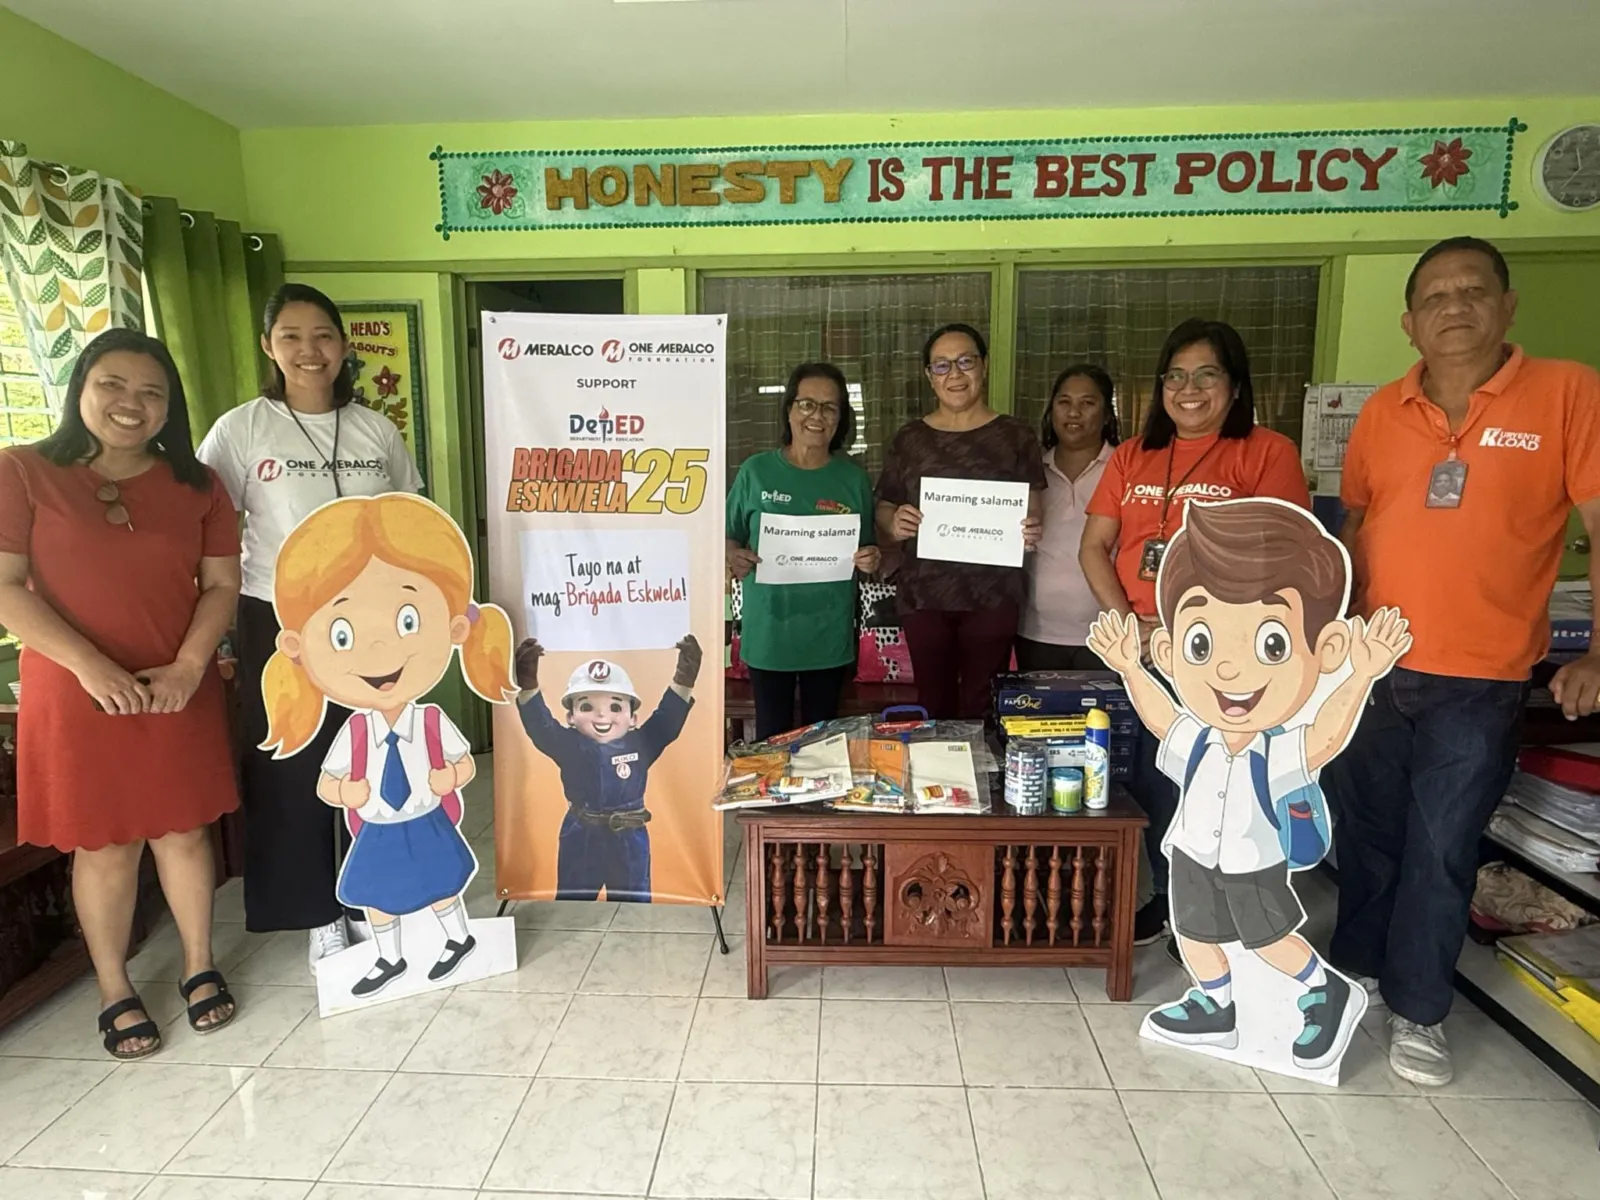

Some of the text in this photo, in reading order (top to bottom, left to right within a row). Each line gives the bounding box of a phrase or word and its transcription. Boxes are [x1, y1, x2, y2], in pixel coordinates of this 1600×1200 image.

[544, 147, 1398, 210] HONESTY IS THE BEST POLICY
[350, 320, 391, 337] HEAD'S
[524, 343, 594, 357] MERALCO
[628, 342, 653, 354] ONE
[656, 342, 714, 354] MERALCO
[576, 378, 637, 389] SUPPORT
[286, 459, 316, 469] ONE
[513, 447, 623, 483] BRIGADA
[506, 480, 629, 513] ESKWELA
[1134, 484, 1164, 496] ONE
[924, 491, 1024, 507] Maraming salamat
[763, 525, 856, 539] Maraming salamat
[951, 525, 1004, 536] ONE MERALCO
[565, 553, 642, 586] Tayo na at
[531, 577, 687, 617] mag-Brigada Eskwela!
[614, 754, 637, 762] KIKO
